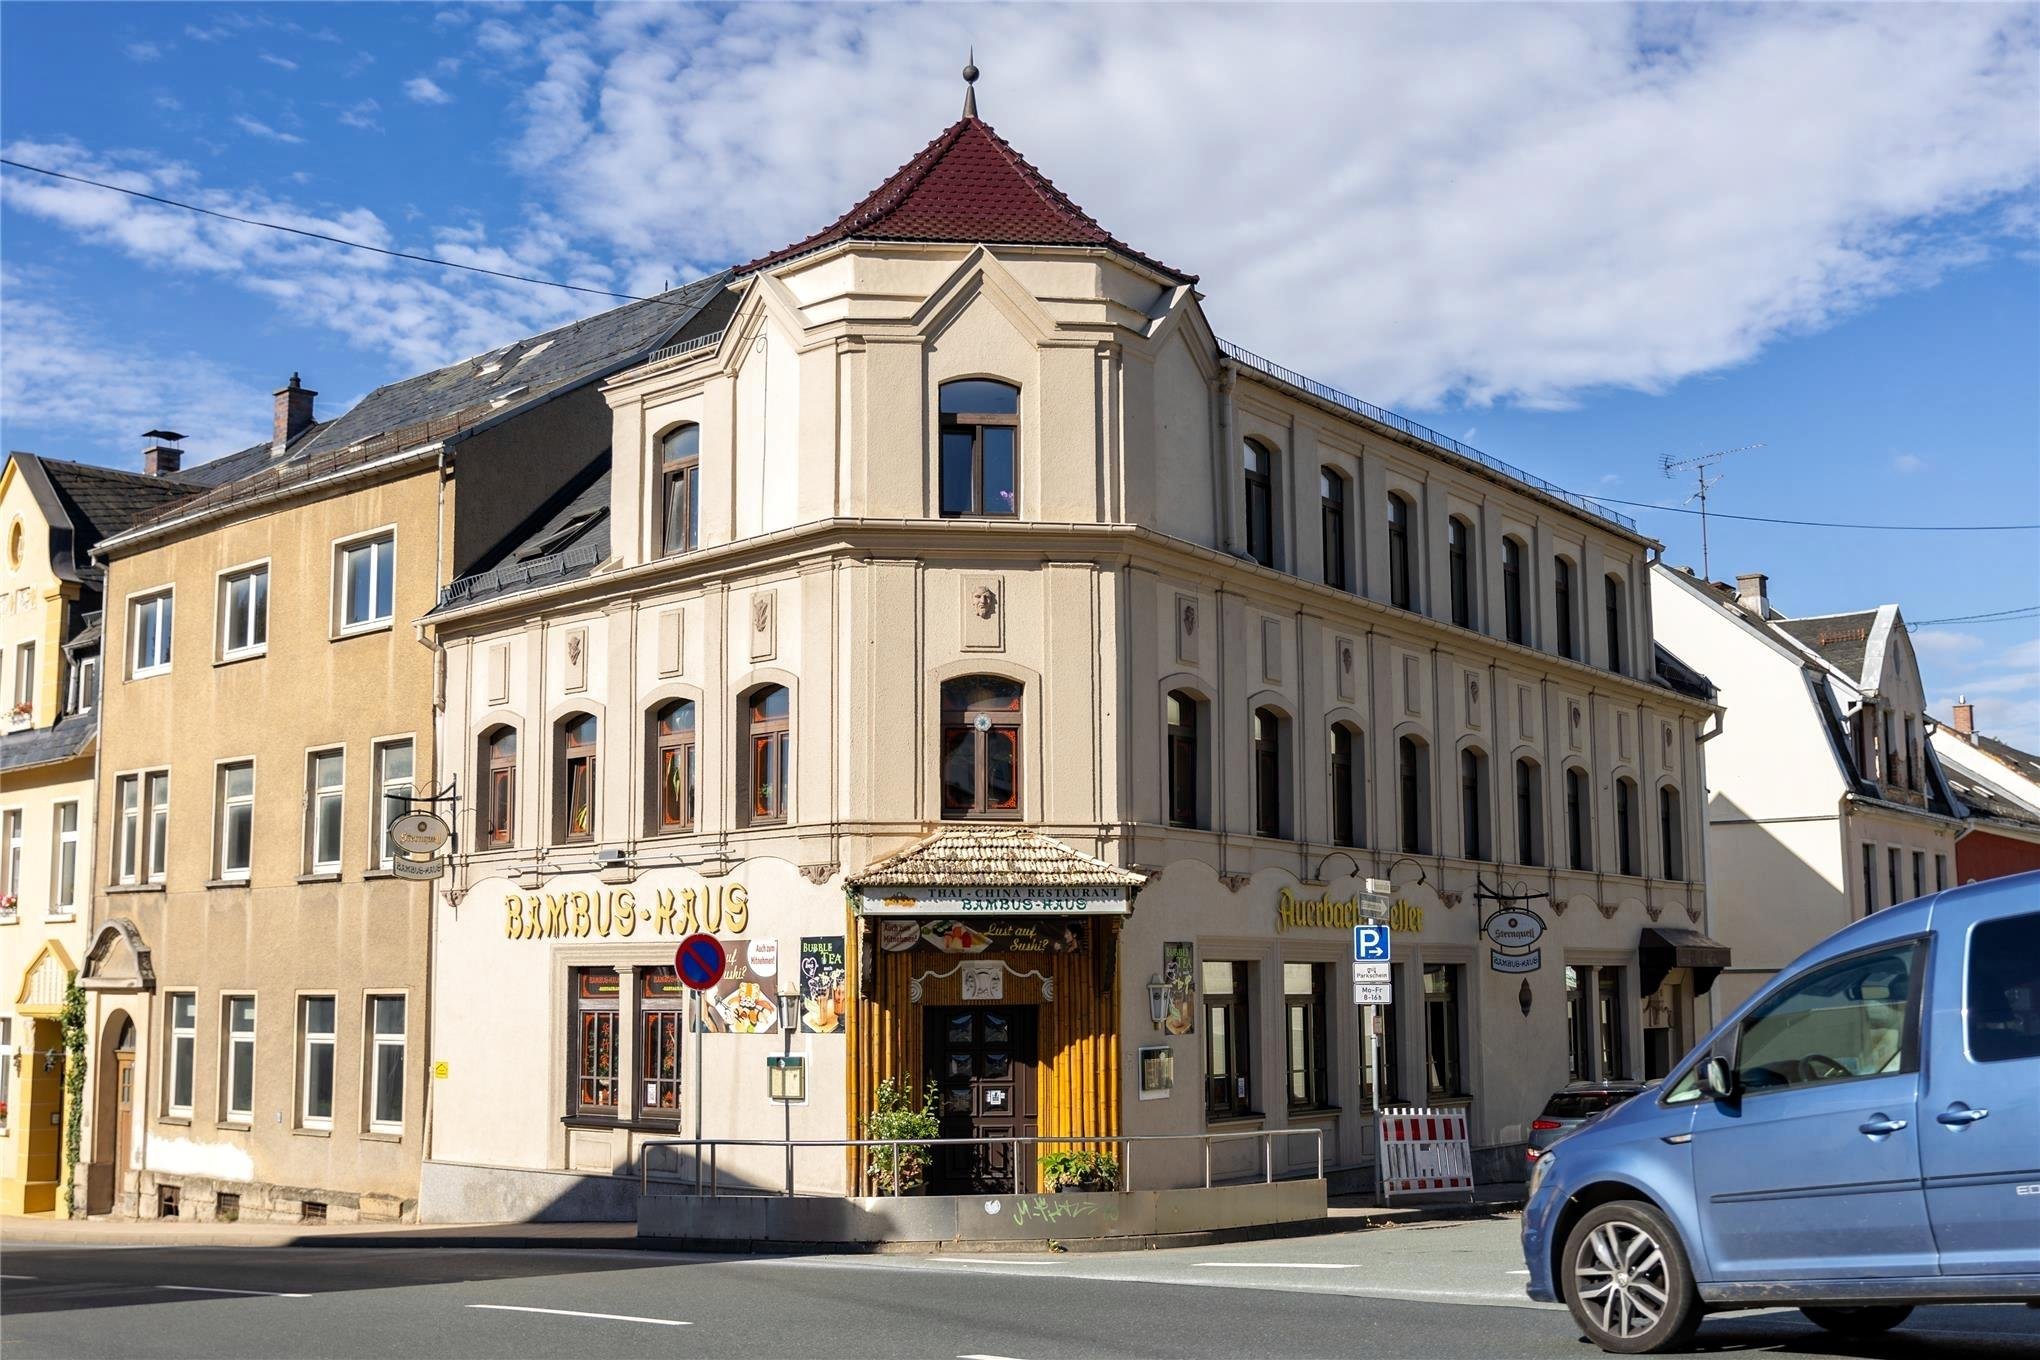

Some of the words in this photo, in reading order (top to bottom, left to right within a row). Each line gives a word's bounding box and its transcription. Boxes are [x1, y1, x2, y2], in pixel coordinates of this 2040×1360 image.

[1028, 888, 1120, 898] RESTAURANT
[962, 898, 1087, 911] BAMBUS-HAUS
[1390, 898, 1425, 933] eller
[984, 922, 1013, 936] Lust
[1014, 924, 1037, 939] auf
[1494, 927, 1535, 940] Sternquell
[803, 942, 833, 953] BUBBLE
[1010, 938, 1049, 952] Sushi?
[1360, 929, 1380, 957] P
[725, 948, 738, 966] uf
[821, 951, 843, 965] TEA
[723, 965, 747, 980] ushi?
